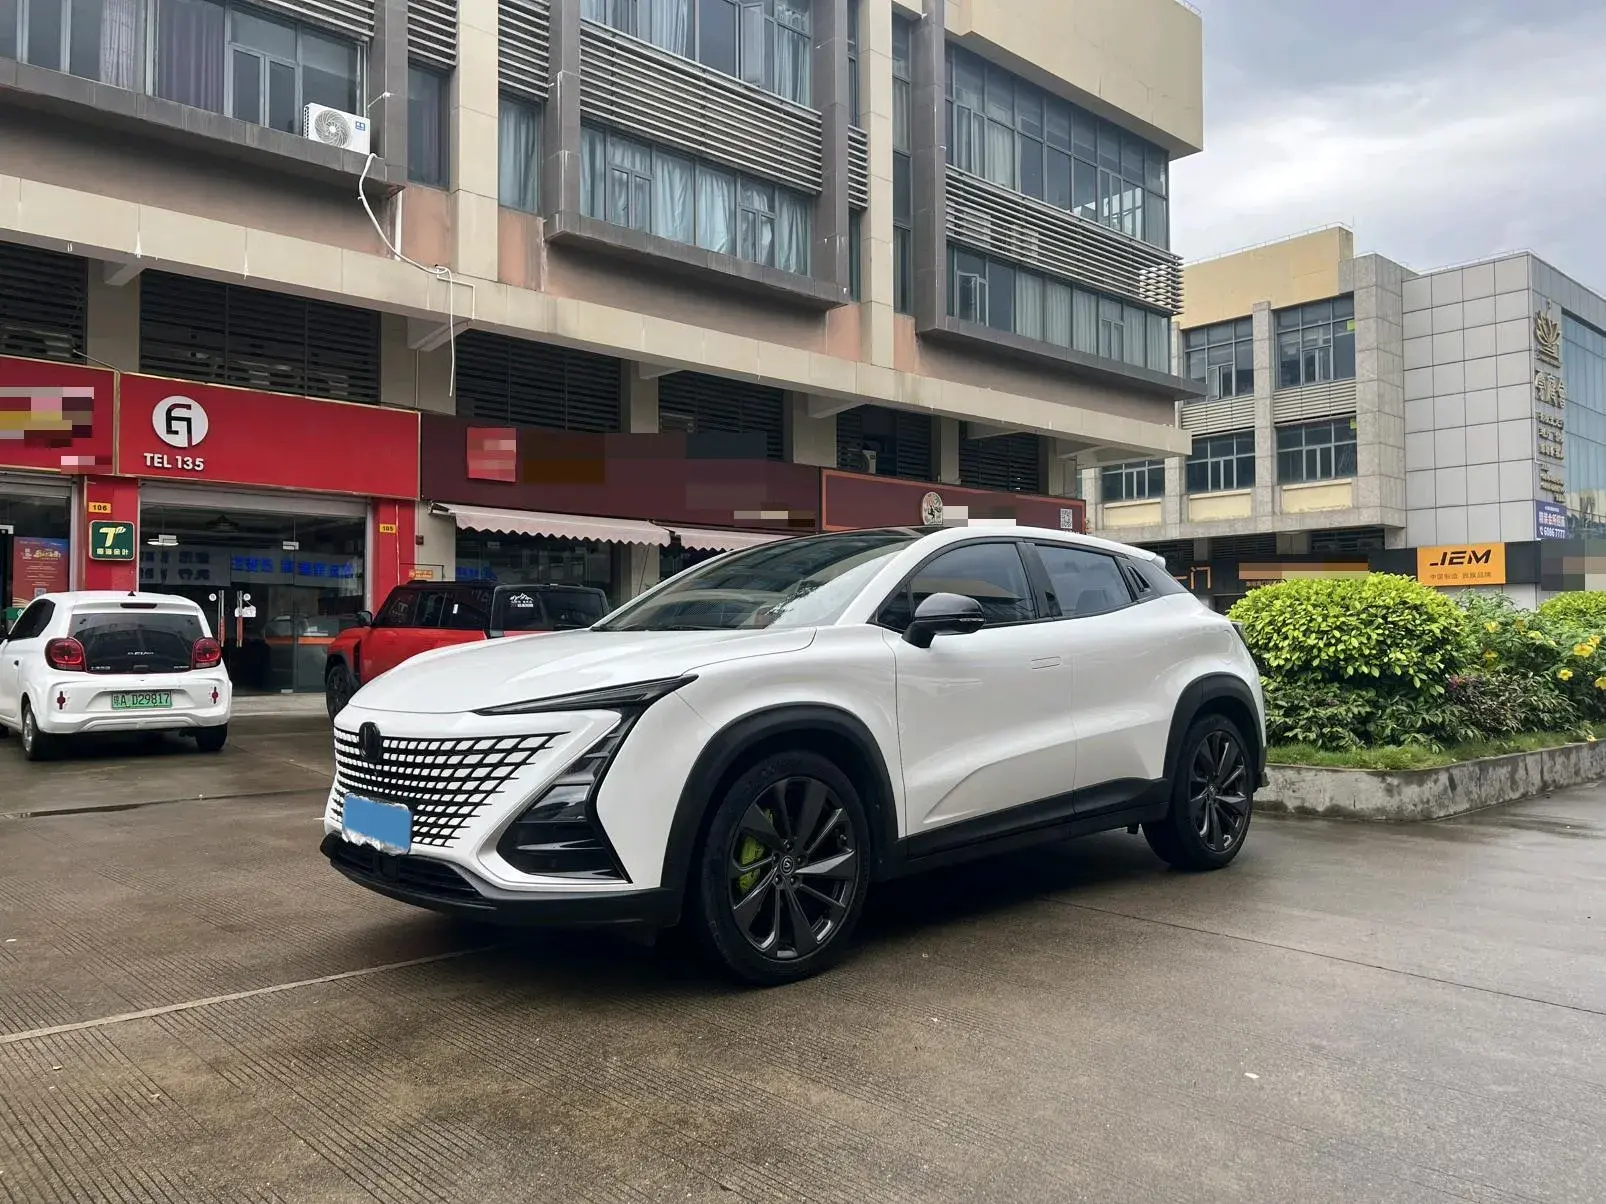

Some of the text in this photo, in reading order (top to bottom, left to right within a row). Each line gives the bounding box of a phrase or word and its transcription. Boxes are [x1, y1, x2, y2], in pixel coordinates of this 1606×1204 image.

[143, 452, 205, 471] TEL 135
[132, 691, 170, 706] D29817
